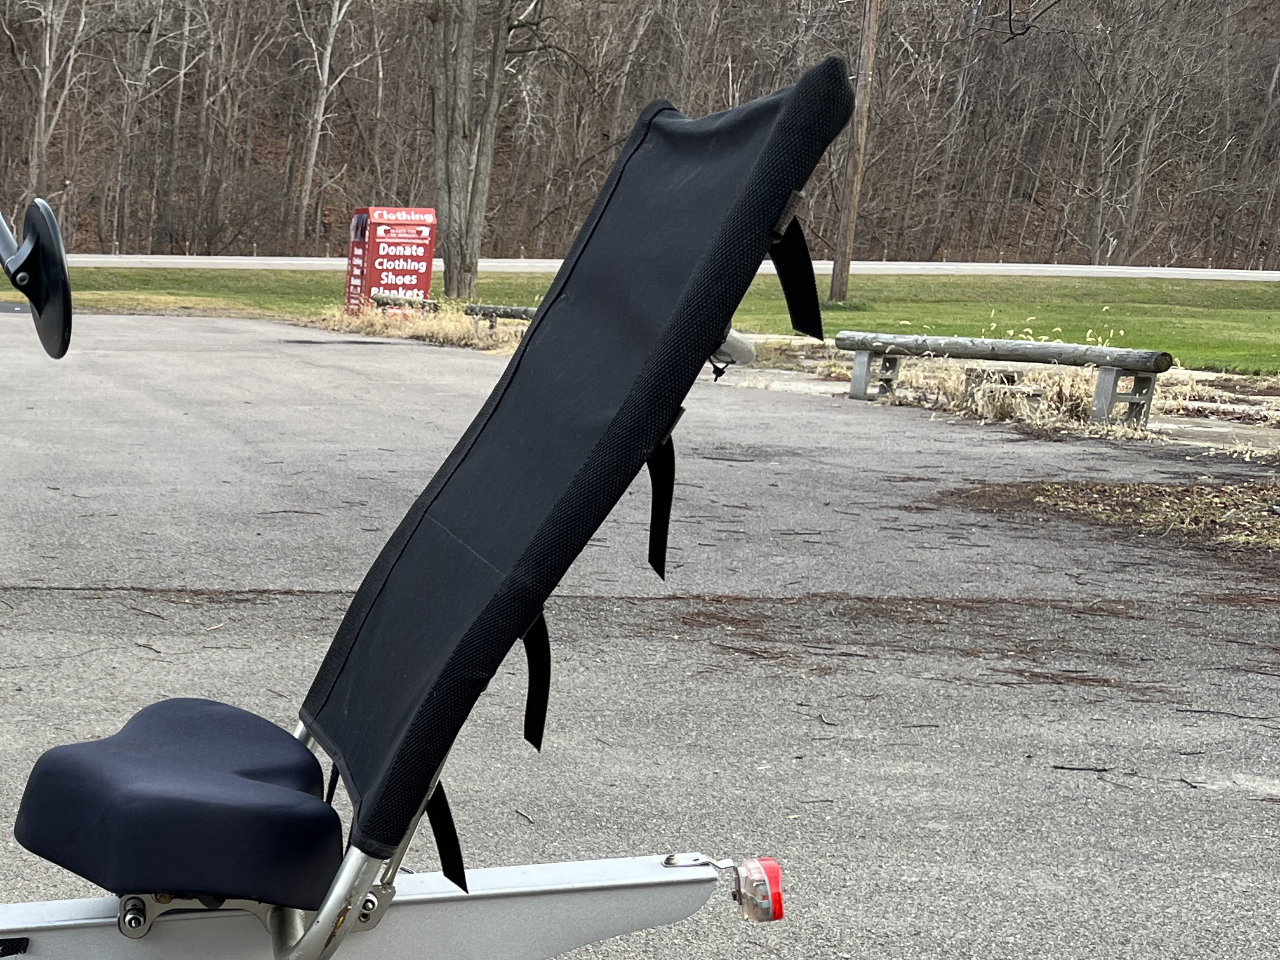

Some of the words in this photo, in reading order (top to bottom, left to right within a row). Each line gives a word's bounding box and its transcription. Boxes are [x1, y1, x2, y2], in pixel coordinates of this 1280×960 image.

[373, 210, 434, 223] Clothing
[379, 243, 425, 256] Donate
[374, 258, 427, 273] Clothing
[380, 272, 418, 285] Shoes
